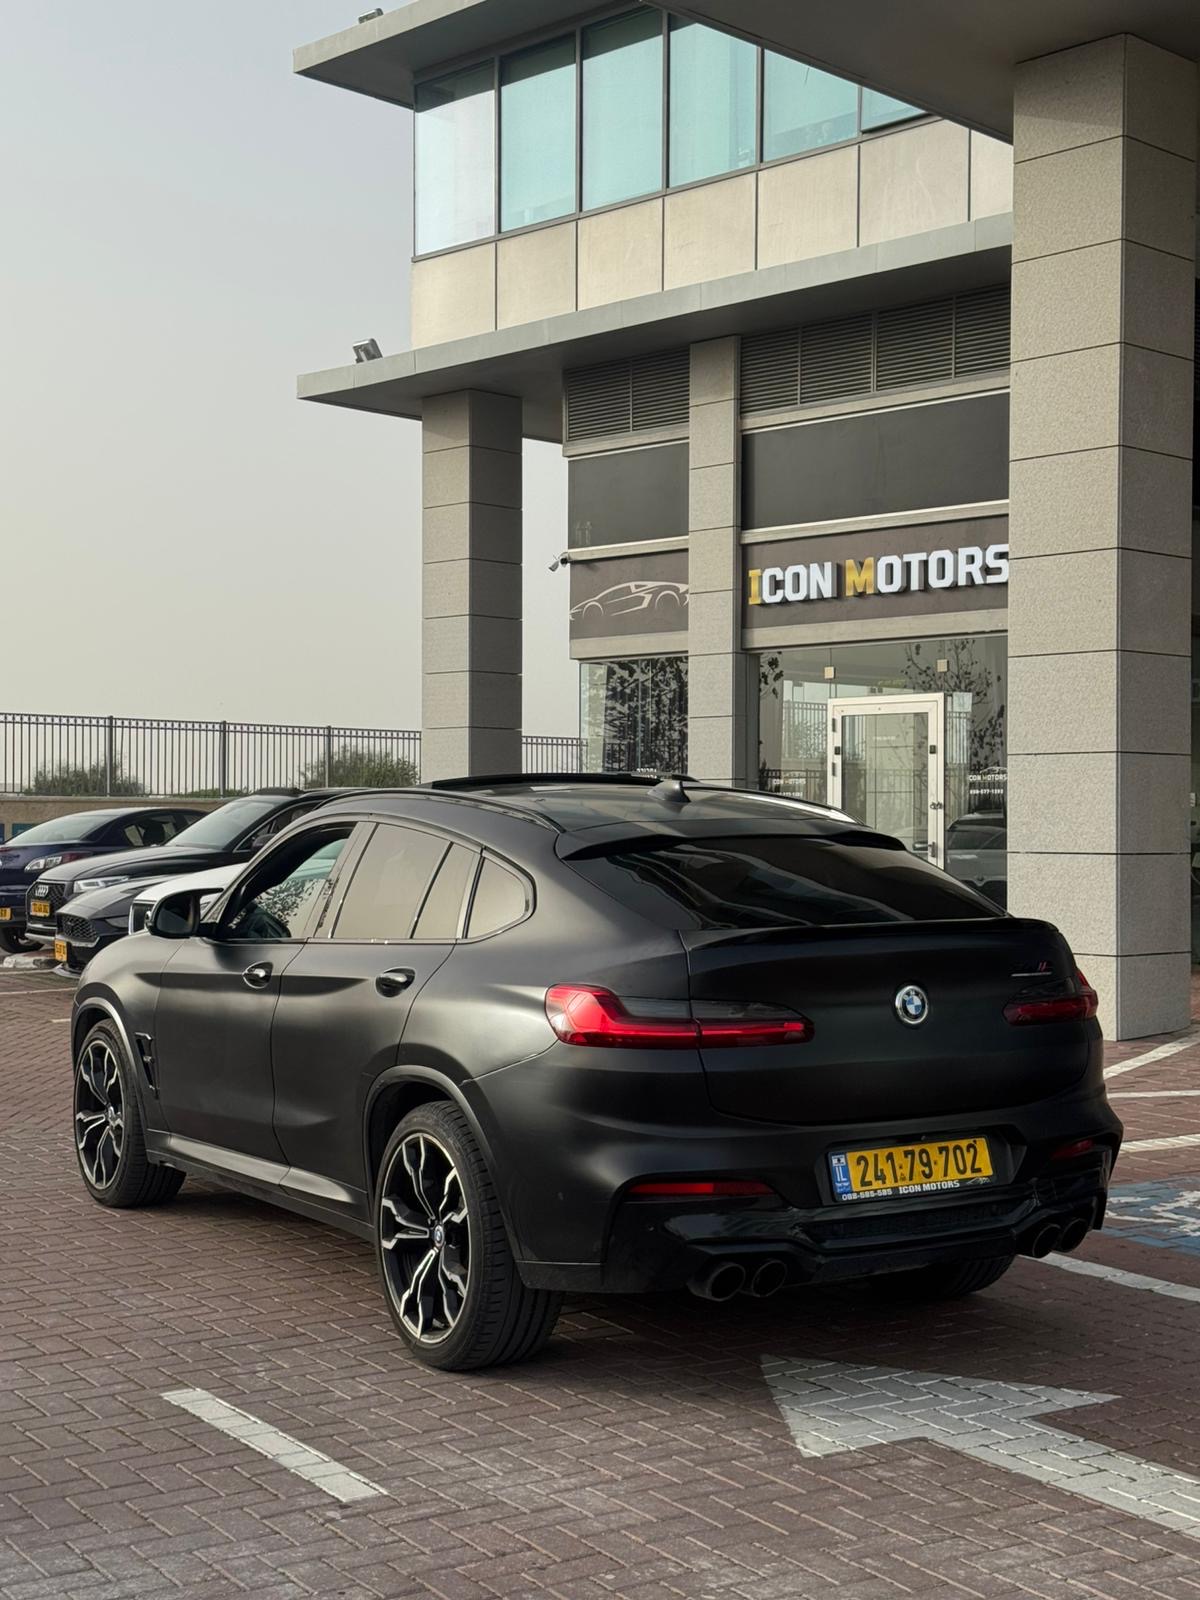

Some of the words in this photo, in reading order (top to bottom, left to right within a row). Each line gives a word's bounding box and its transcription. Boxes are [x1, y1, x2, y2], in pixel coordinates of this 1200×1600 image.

[748, 561, 834, 605] ICON
[845, 543, 1009, 597] MOTORS
[835, 1166, 848, 1182] IL
[898, 1184, 922, 1195] ICON
[923, 1179, 961, 1192] MOTORS
